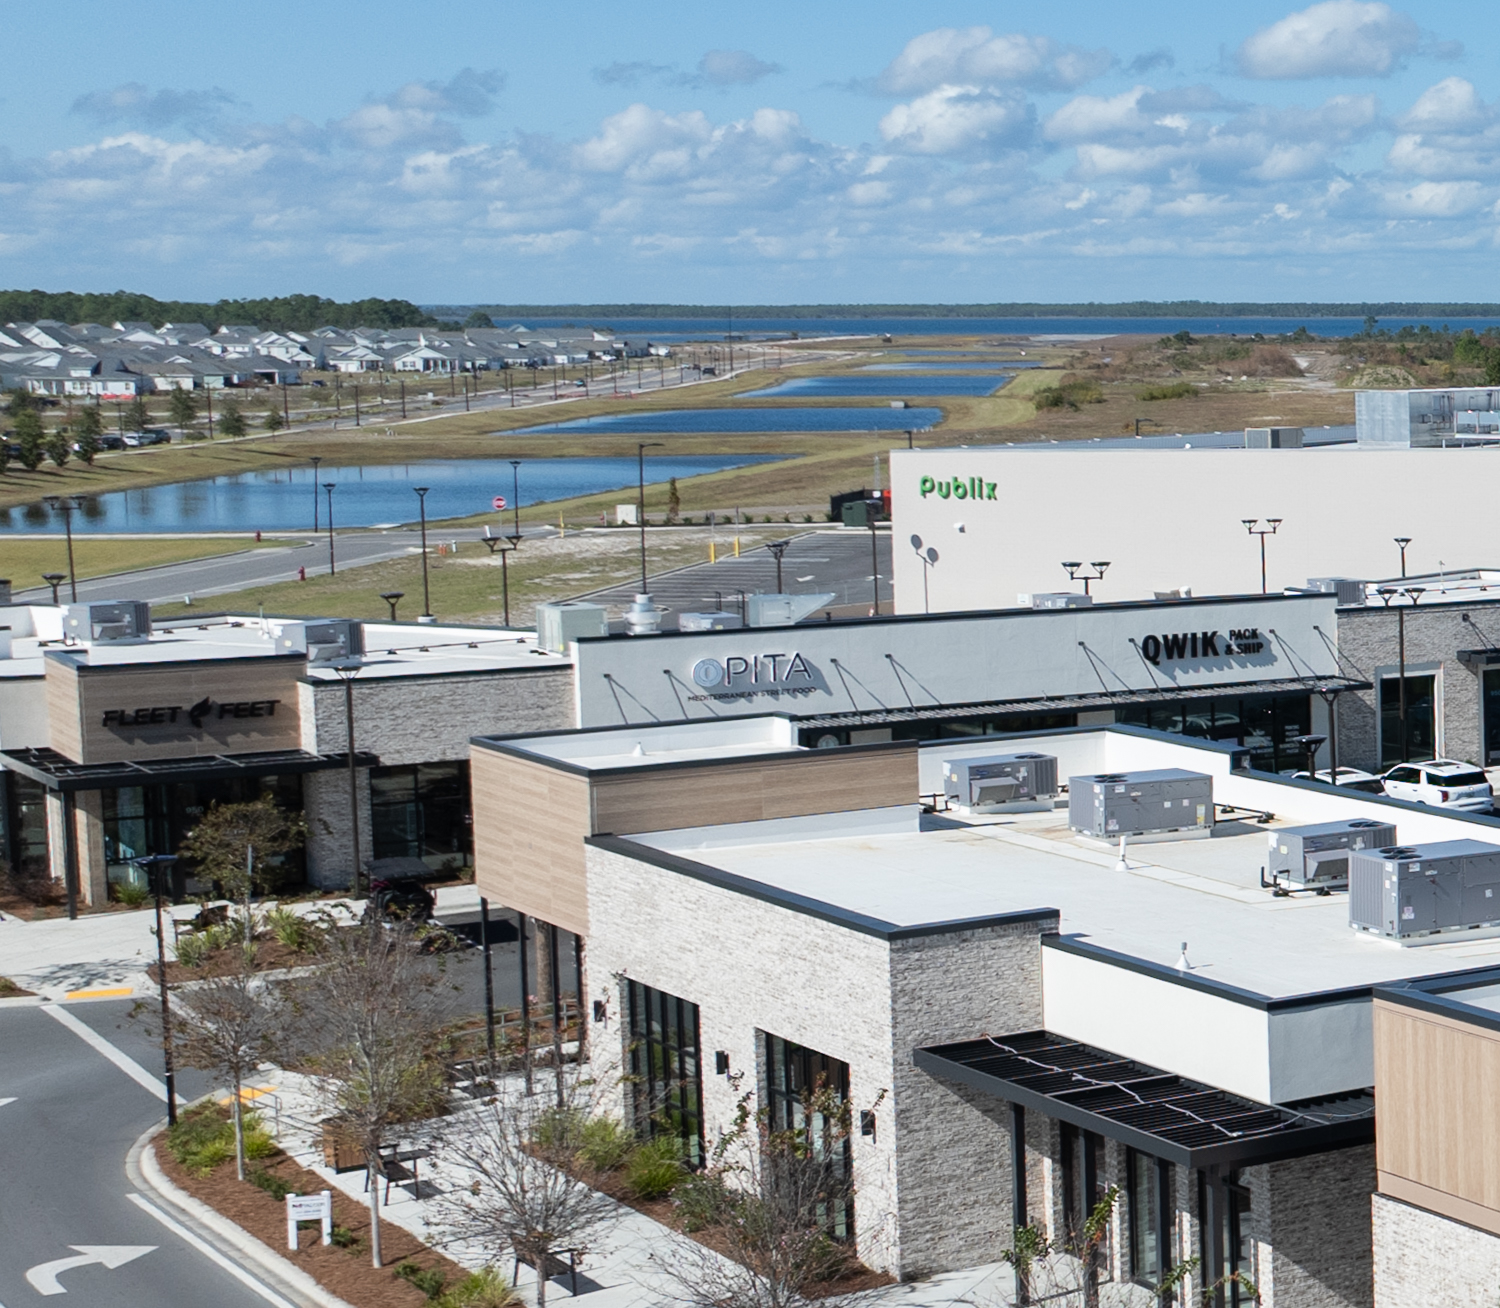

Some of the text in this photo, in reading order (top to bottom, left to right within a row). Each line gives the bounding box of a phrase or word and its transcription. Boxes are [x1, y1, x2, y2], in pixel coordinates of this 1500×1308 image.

[920, 475, 998, 500] Publix
[1229, 628, 1258, 641] PACK
[1142, 631, 1220, 666] QWIK
[1224, 642, 1264, 656] & SHIP
[688, 686, 817, 702] MEDITERRANEAN STREET FOOD
[103, 700, 281, 727] FLEET FEET
